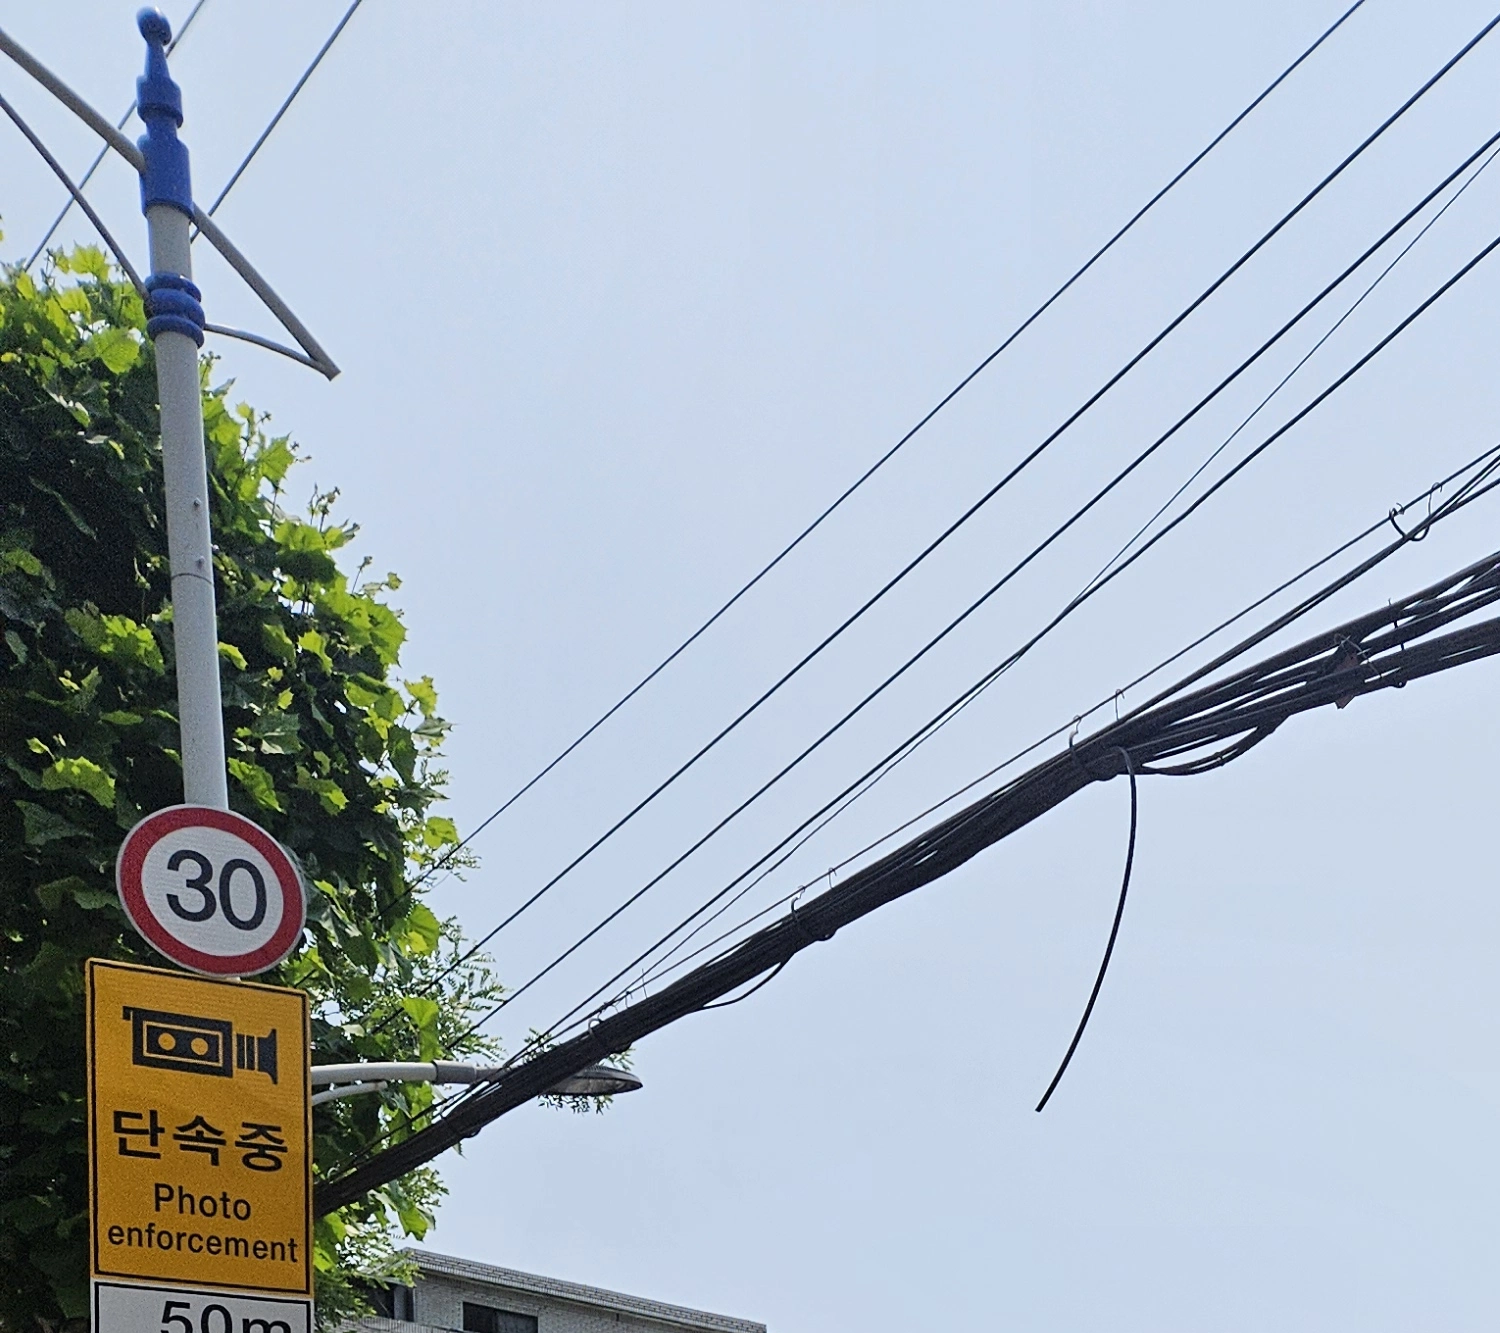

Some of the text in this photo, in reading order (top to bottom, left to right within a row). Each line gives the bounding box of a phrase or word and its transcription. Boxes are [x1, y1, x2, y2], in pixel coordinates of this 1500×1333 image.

[166, 849, 266, 932] 30
[112, 1109, 288, 1172] 단속중
[153, 1182, 252, 1221] Photo
[107, 1223, 299, 1263] enforcement
